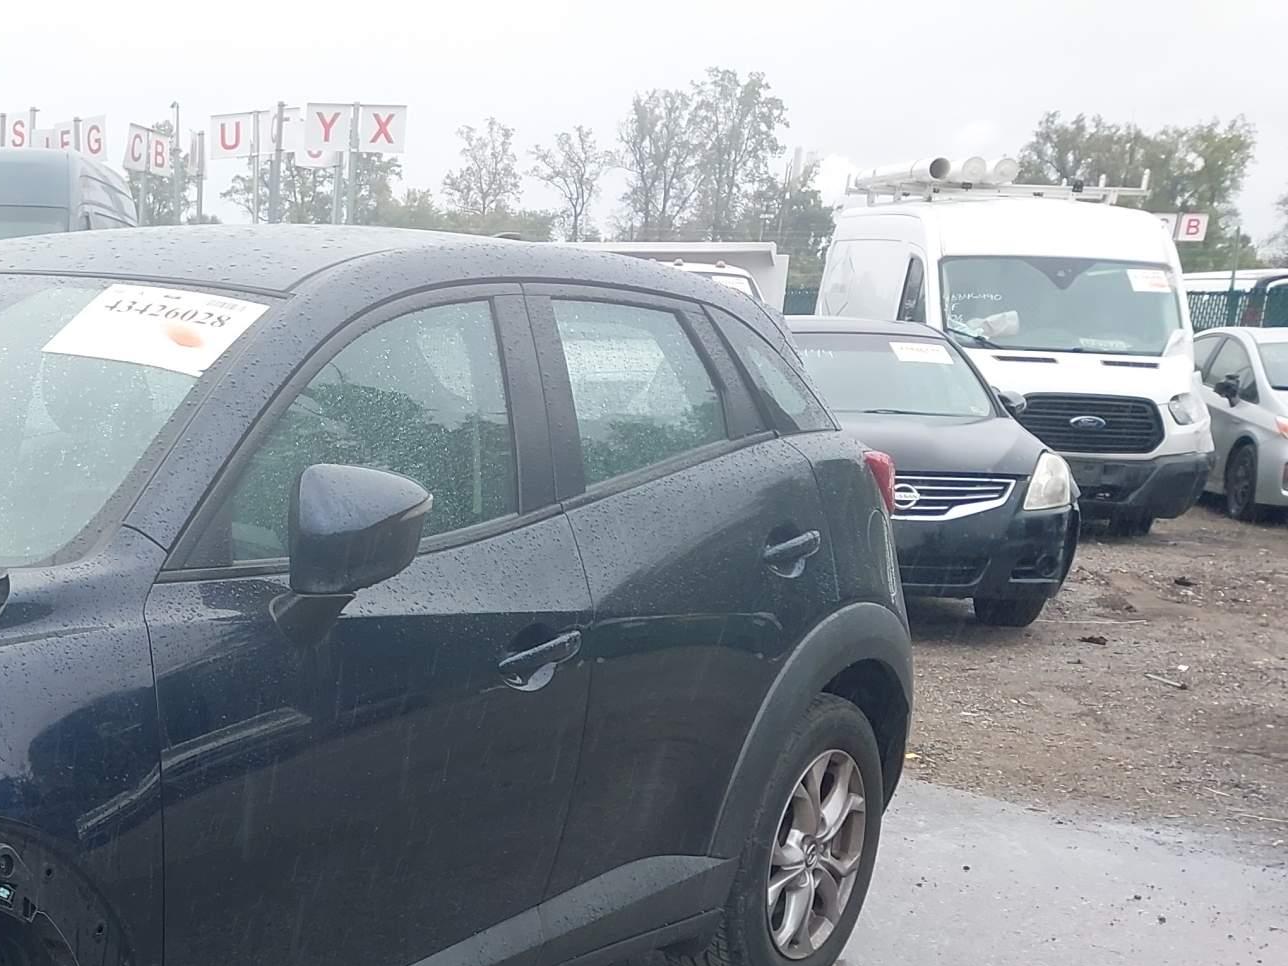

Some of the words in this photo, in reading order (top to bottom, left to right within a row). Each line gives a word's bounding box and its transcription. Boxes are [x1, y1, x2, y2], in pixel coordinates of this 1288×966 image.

[11, 120, 25, 147] S
[87, 125, 102, 155] G
[220, 121, 241, 150] U
[316, 111, 342, 142] Y
[369, 113, 396, 144] X
[131, 134, 143, 162] C
[154, 140, 165, 168] B
[1185, 219, 1201, 235] B
[104, 299, 232, 328] 43426028
